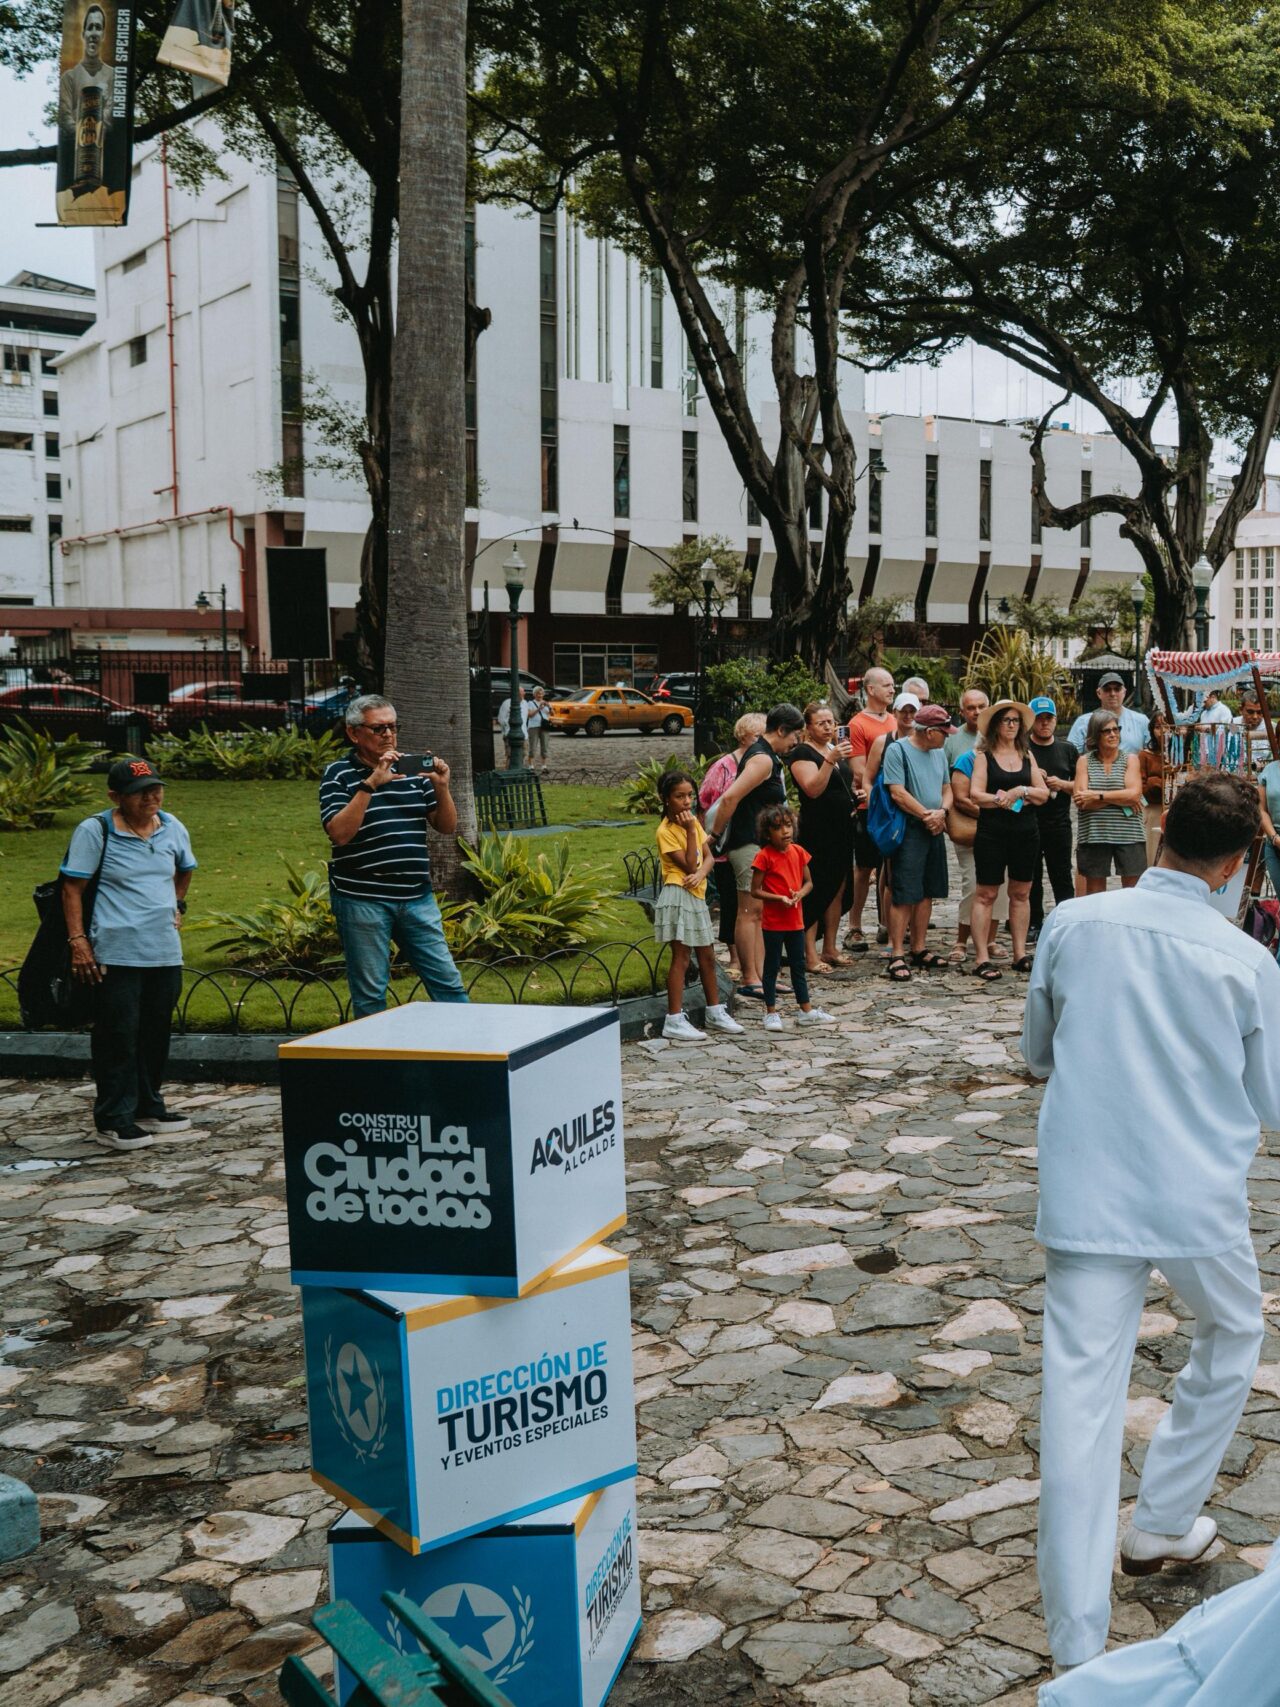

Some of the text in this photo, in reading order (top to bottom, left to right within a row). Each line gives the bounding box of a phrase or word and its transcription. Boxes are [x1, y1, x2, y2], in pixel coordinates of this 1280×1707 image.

[112, 9, 131, 118] ALBERTO SPENCER
[338, 1112, 418, 1130] CONSTRU
[360, 1127, 419, 1144] YENDO
[420, 1115, 471, 1155] La
[529, 1099, 616, 1176] AQUILES
[564, 1133, 616, 1175] ALCALDE
[303, 1138, 491, 1197] Ciudad
[306, 1187, 492, 1230] de todos
[436, 1340, 608, 1415] DIRECCIÓN DE
[437, 1368, 608, 1452] TURISMO
[440, 1405, 609, 1471] Y EVENTOS ESPECIALES
[585, 1509, 632, 1609] DIRECCIÓN DE
[586, 1534, 633, 1642] TURISMO
